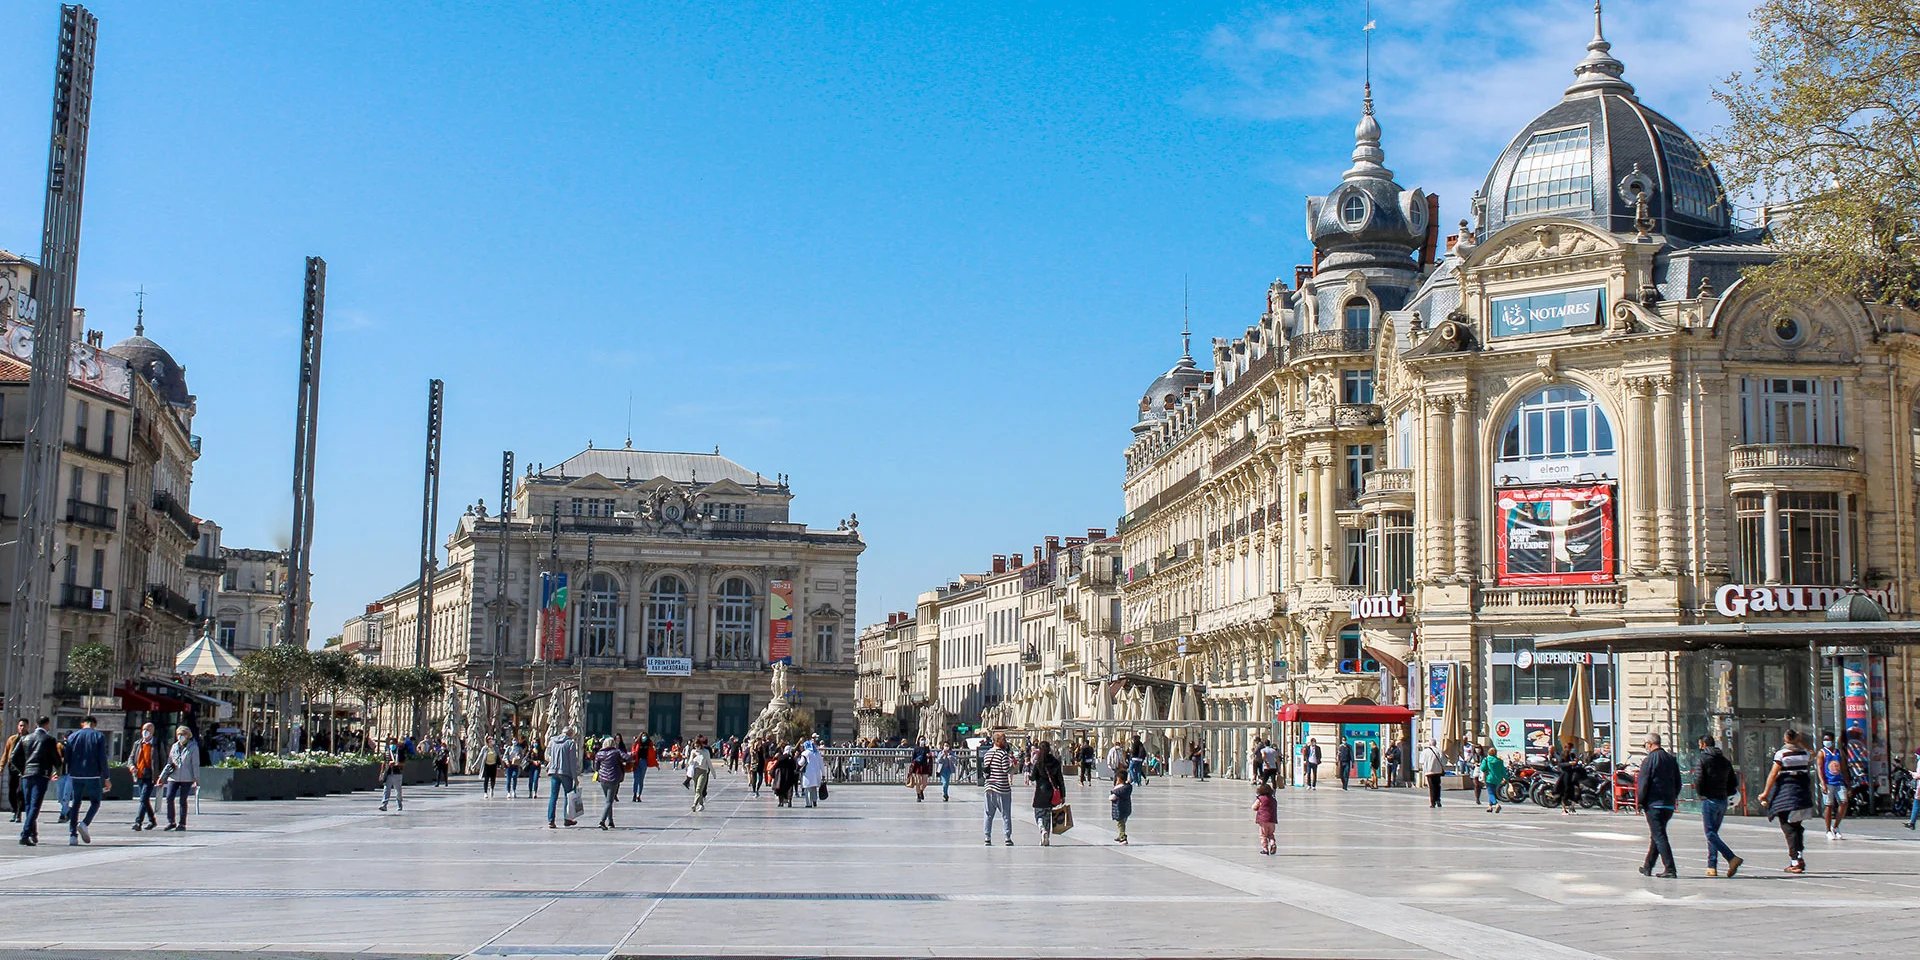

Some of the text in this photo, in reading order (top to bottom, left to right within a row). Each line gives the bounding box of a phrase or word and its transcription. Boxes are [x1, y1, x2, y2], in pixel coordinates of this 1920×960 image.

[1527, 303, 1590, 321] NOTAIRES
[1540, 464, 1569, 473] eleom
[1715, 582, 1899, 617] Gaumnt
[1340, 659, 1375, 673] CIC
[1846, 704, 1856, 712] LES
